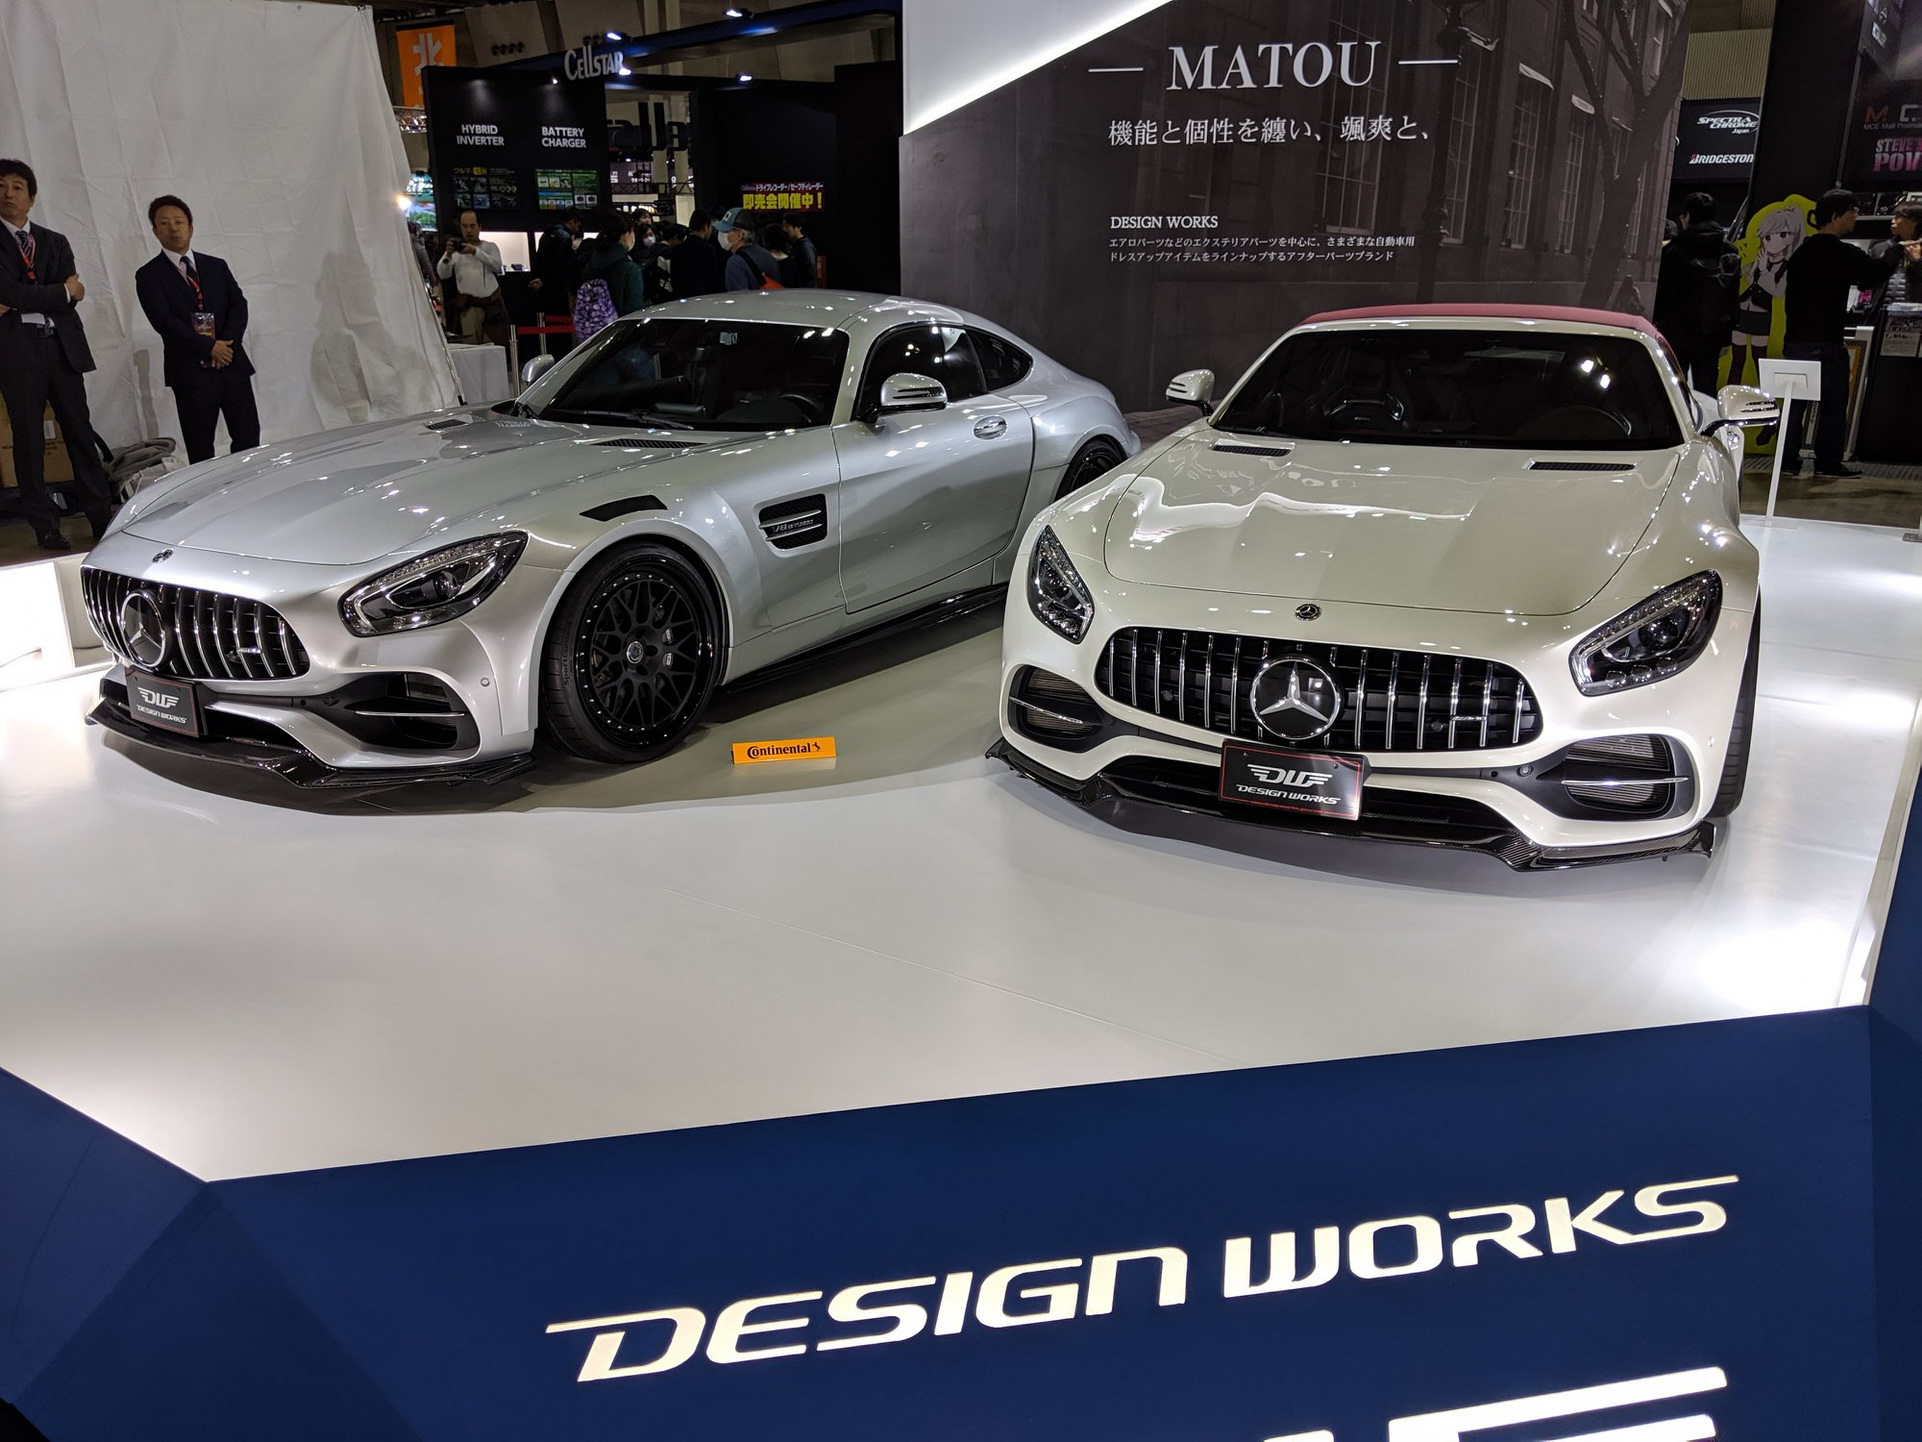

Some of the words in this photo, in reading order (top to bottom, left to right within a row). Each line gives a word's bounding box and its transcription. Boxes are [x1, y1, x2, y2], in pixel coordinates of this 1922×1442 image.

[1165, 41, 1382, 90] MATOU
[461, 123, 499, 135] HYBRID
[541, 126, 585, 138] BATTERY
[456, 135, 505, 147] INVERTER
[541, 137, 587, 149] CHARGER
[1109, 215, 1163, 230] DESIGN
[1165, 215, 1219, 230] WORKS
[136, 703, 161, 718] DESIGN
[746, 742, 811, 760] Continental
[1235, 783, 1287, 799] DESIGN
[1287, 791, 1342, 806] WORKS
[545, 1246, 1188, 1383] DESIGN
[1222, 1175, 1740, 1299] WORKS
